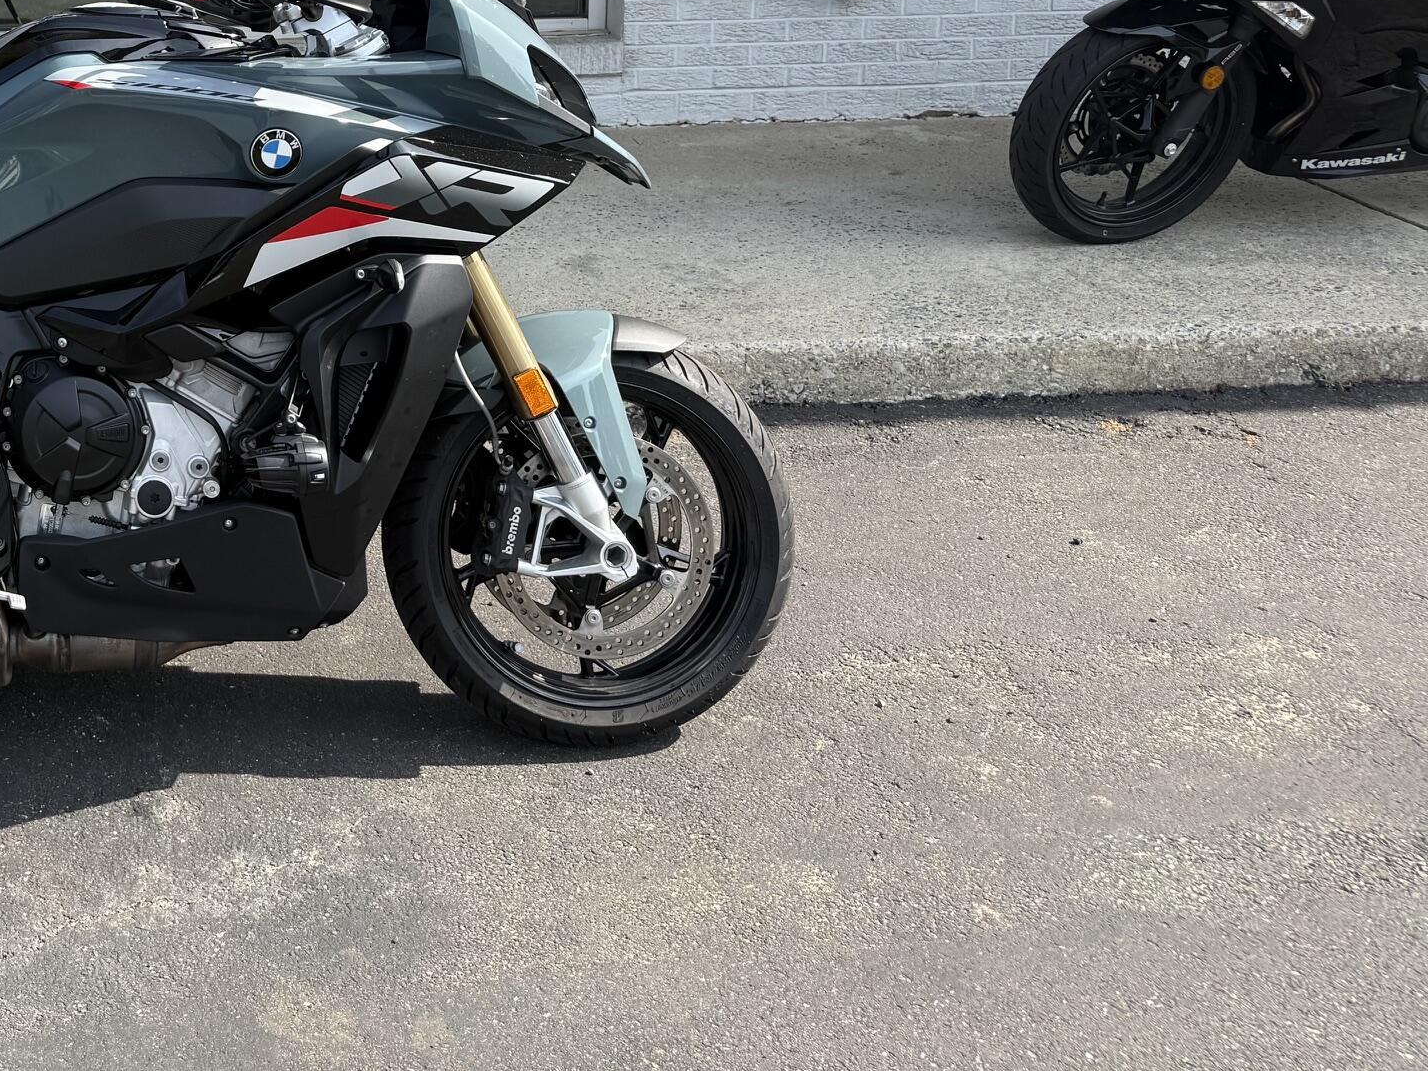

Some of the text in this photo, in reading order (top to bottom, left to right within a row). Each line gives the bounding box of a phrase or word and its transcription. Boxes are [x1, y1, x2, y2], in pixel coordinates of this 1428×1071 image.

[259, 130, 300, 150] BMW
[1300, 150, 1407, 169] Kawasaki
[502, 506, 522, 555] brembo
